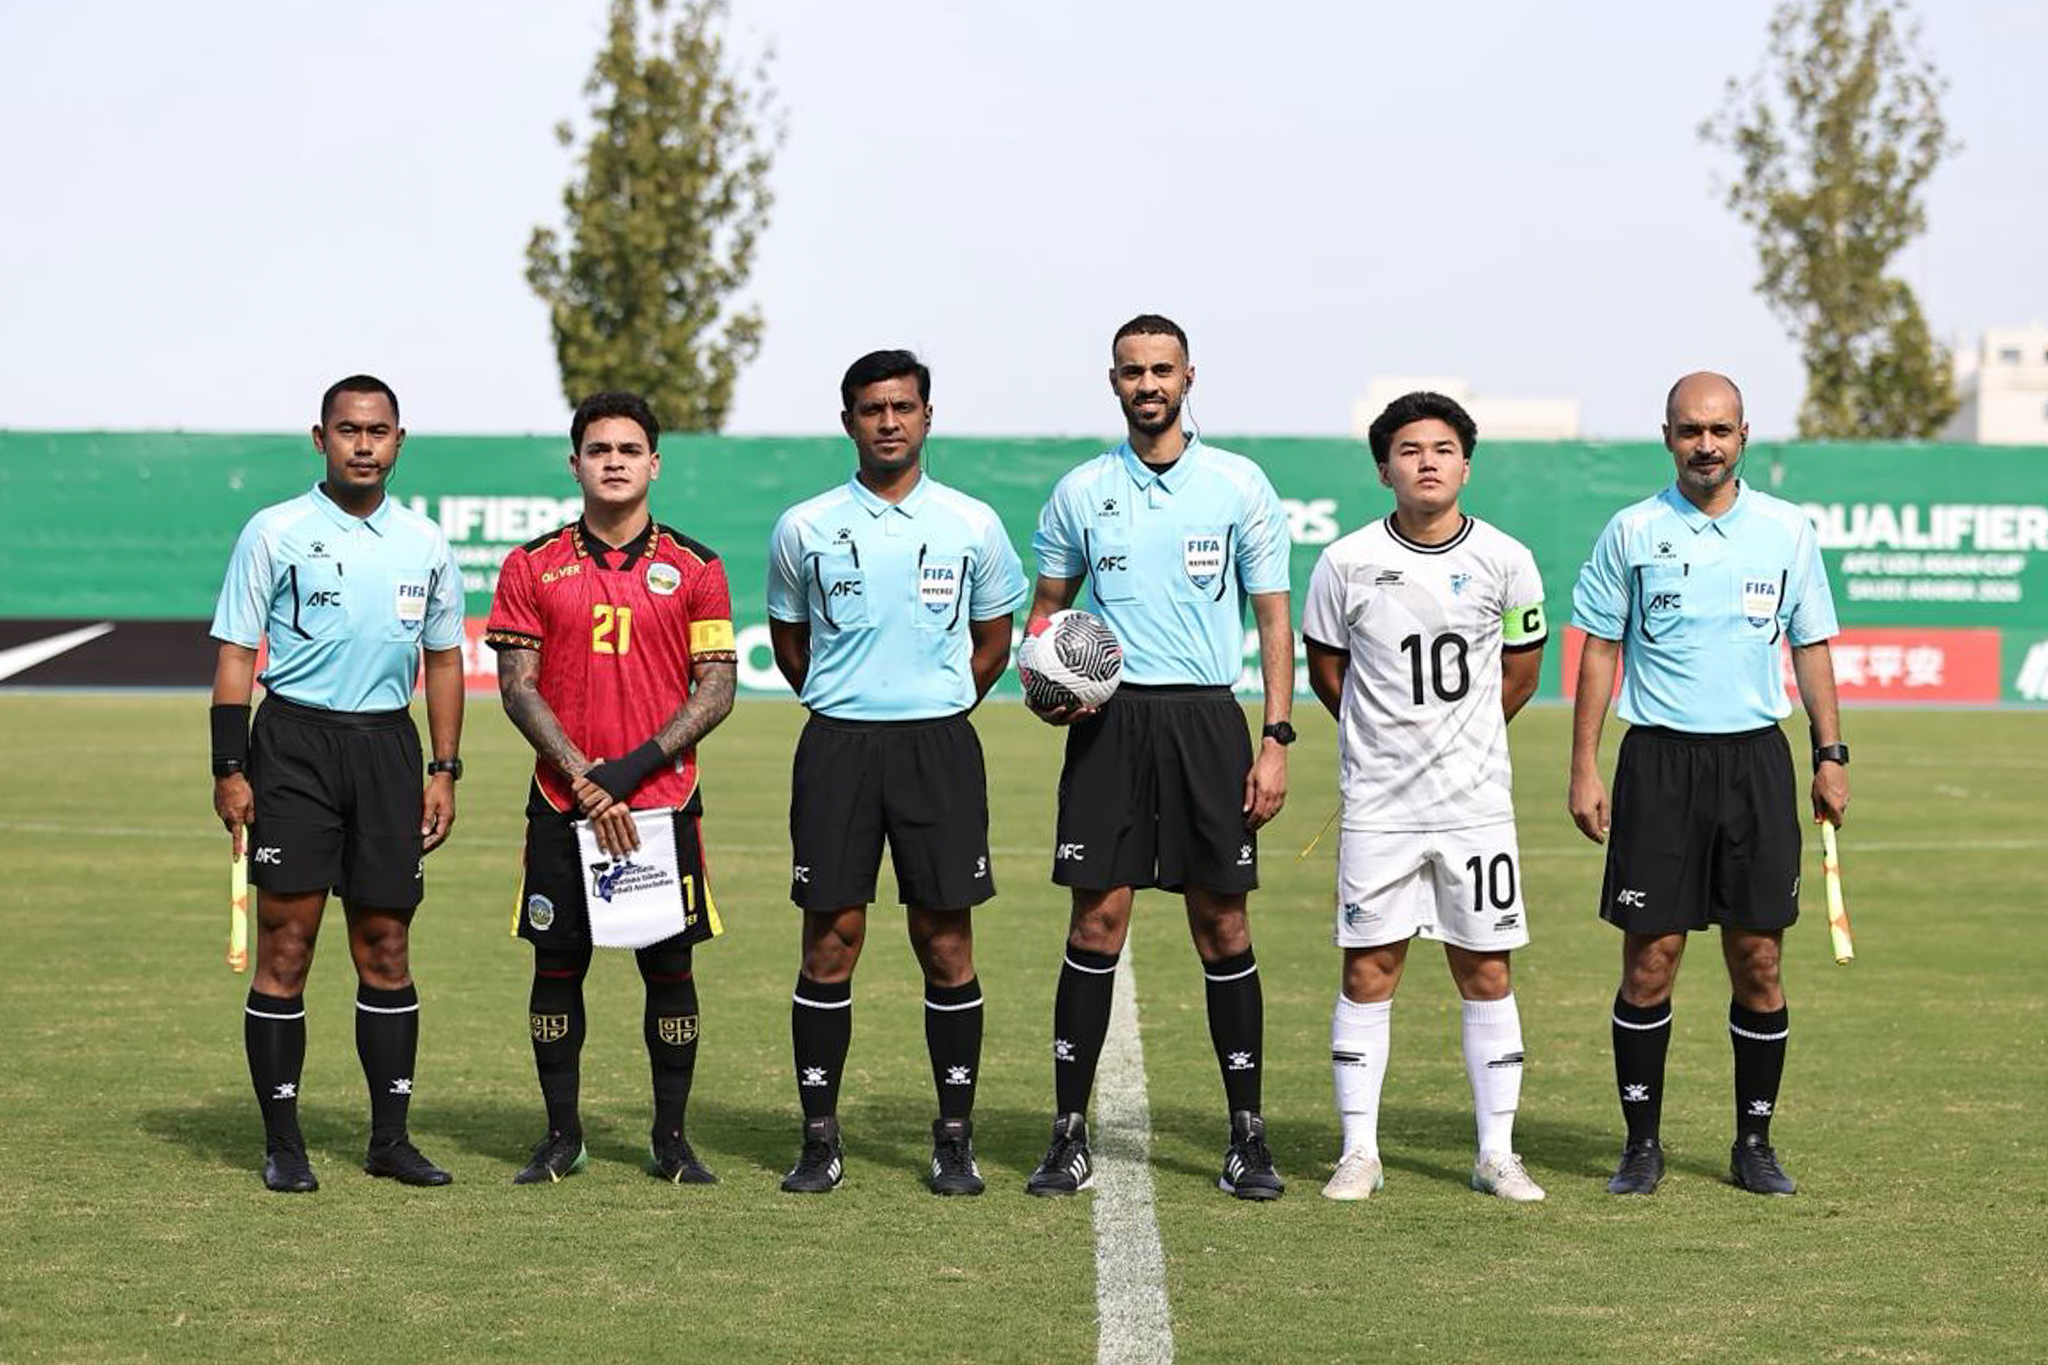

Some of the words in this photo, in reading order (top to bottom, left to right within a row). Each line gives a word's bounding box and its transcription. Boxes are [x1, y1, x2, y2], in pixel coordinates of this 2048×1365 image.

[1188, 541, 1219, 552] FIFA
[1096, 556, 1127, 571] AFC
[541, 564, 581, 584] OLIVER
[923, 568, 954, 580] FIFA
[400, 585, 425, 598] FIFA
[829, 581, 862, 596] AFC
[1745, 583, 1775, 595] FIFA
[306, 592, 341, 606] AFC
[1649, 594, 1681, 609] AFC
[592, 603, 632, 655] 21
[1522, 608, 1541, 633] C
[1400, 632, 1470, 706] 10
[255, 847, 281, 864] AFC
[794, 866, 810, 883] FC
[1466, 853, 1516, 912] 10
[683, 874, 697, 912] 1
[1617, 888, 1647, 908] AFC
